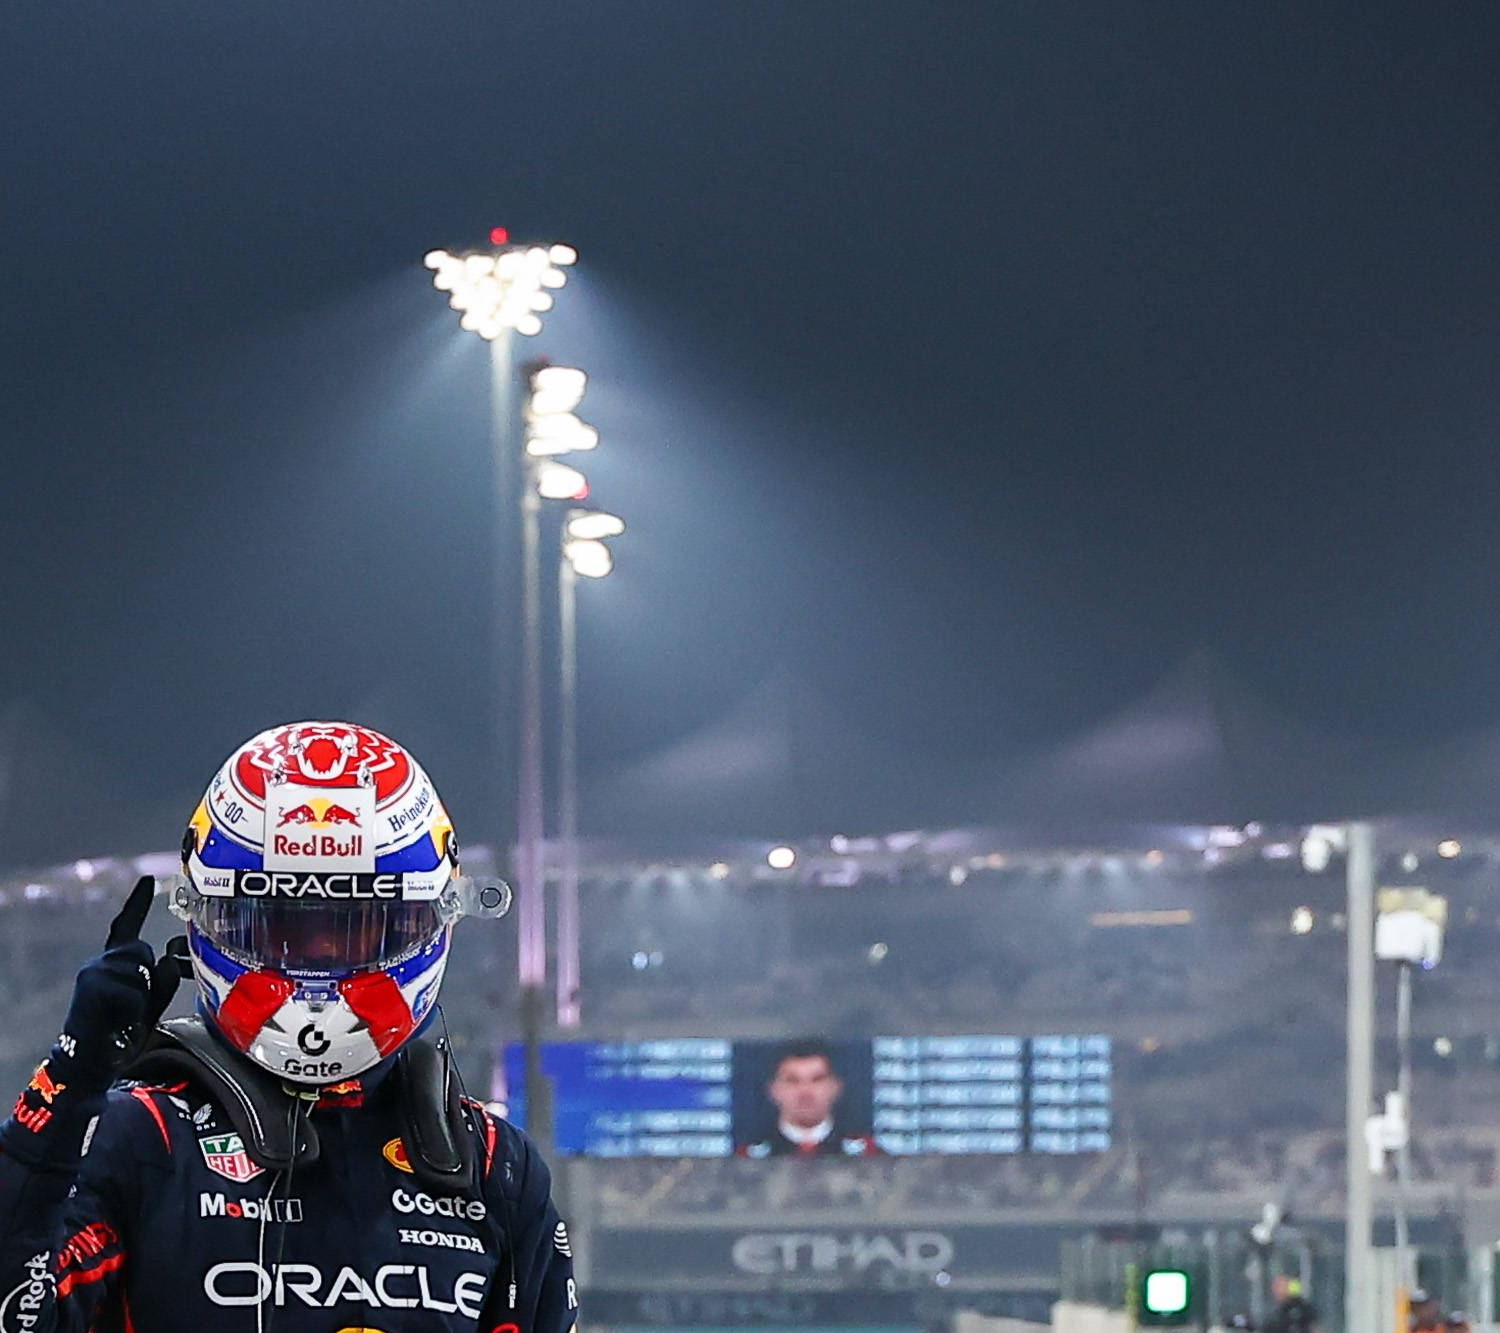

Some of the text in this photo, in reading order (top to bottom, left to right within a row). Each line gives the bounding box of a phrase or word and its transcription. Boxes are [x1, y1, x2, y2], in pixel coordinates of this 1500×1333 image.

[274, 834, 363, 857] Red Bull
[240, 872, 397, 899] ORACLE
[284, 1058, 343, 1077] Gate
[212, 1138, 246, 1152] TA
[200, 1192, 273, 1223] Mobil
[416, 1190, 487, 1221] Gate
[397, 1228, 486, 1255] HONDA
[18, 1250, 52, 1314] Rock
[204, 1262, 488, 1320] ORACLE
